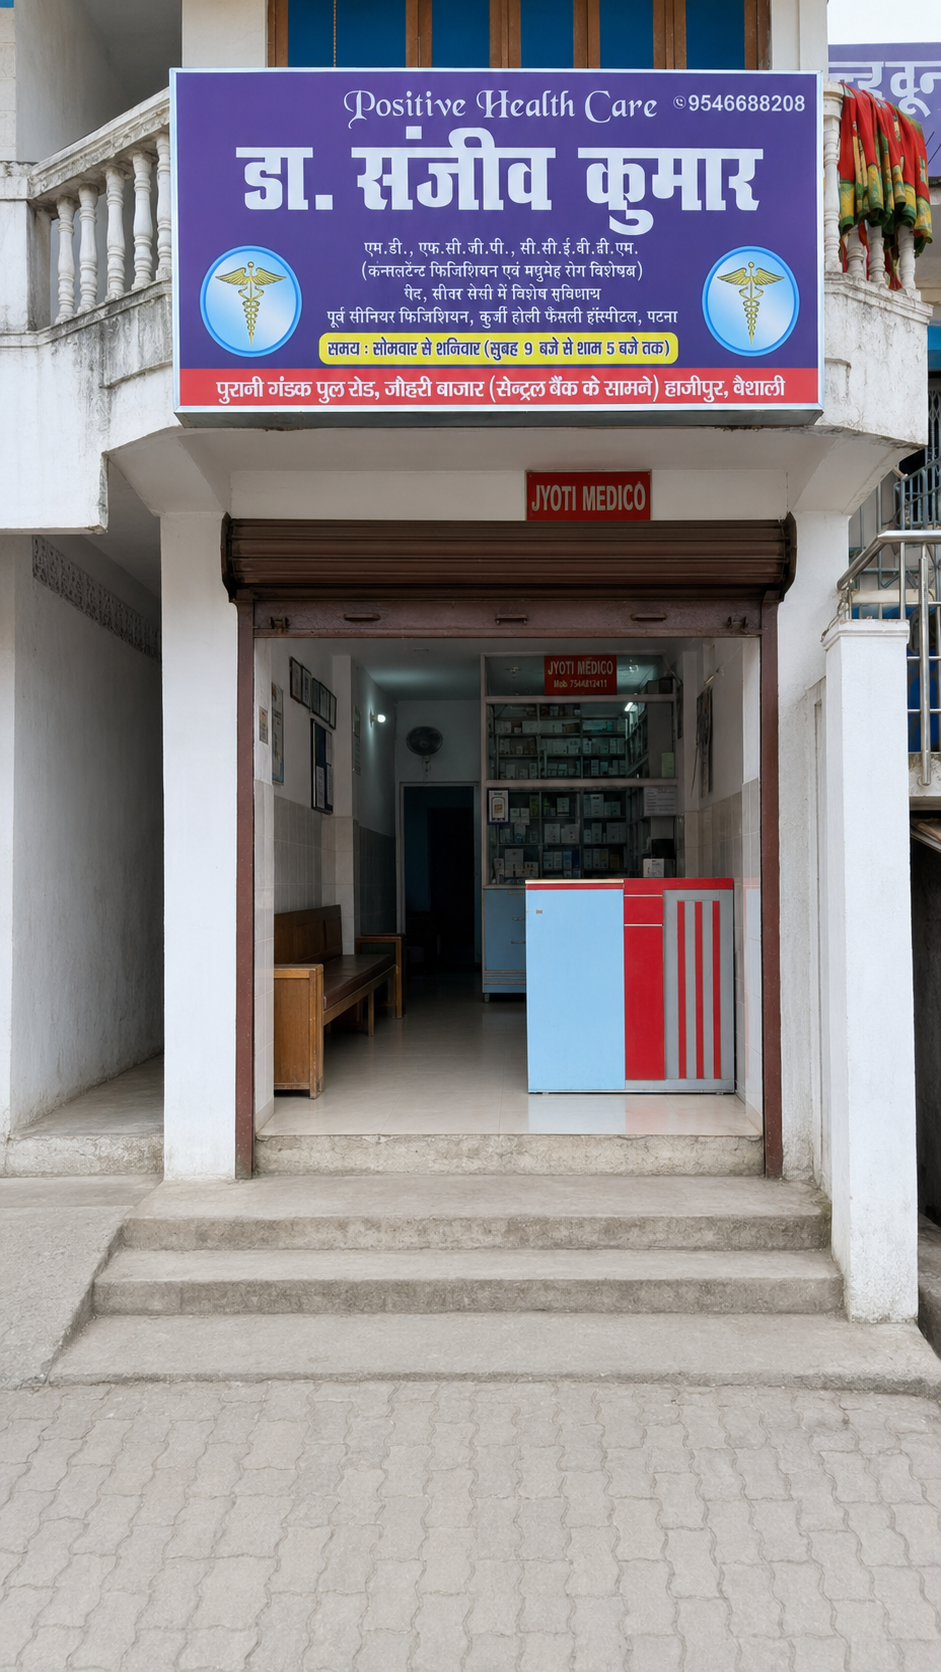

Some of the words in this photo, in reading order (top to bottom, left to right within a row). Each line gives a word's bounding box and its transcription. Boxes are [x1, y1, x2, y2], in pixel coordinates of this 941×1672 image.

[344, 90, 466, 129] Positive
[476, 90, 575, 118] Health
[584, 90, 657, 123] Care
[688, 95, 805, 111] 9546688208
[236, 147, 333, 210] डा.
[351, 126, 556, 210] संजीव
[578, 147, 764, 236] कुमार
[429, 261, 498, 280] फिजिशियन
[502, 261, 520, 279] एवं
[565, 260, 586, 278] रोग
[497, 283, 507, 300] में
[327, 306, 345, 328] पूर्व
[349, 306, 395, 323] सीनियर
[399, 306, 474, 326] फिजिशियन,
[511, 306, 541, 325] होली
[647, 310, 678, 323] पटना
[328, 342, 360, 356] समय
[373, 337, 418, 356] सोमवार
[421, 337, 432, 356] से
[437, 337, 481, 356] शनिवार
[524, 342, 533, 356] 9
[539, 337, 558, 356] बजे
[563, 337, 573, 356] से
[577, 341, 602, 356] शाम
[606, 342, 615, 355] 5
[619, 336, 638, 356] बजे
[642, 339, 670, 357] तक)
[216, 375, 264, 404] पुरानी
[267, 376, 312, 397] गंडक
[316, 381, 345, 403] पुल
[348, 376, 380, 400] रोड,
[384, 376, 432, 398] जौहरी
[436, 381, 485, 398] बाजार
[549, 375, 579, 397] बैंक
[582, 375, 600, 397] के
[604, 375, 659, 402] सामने)
[664, 375, 729, 403] हाजीपुर,
[531, 484, 577, 512] JYOTI
[582, 481, 646, 511] MEDICO
[548, 660, 575, 675] JYOTI
[577, 660, 614, 675] MEDICO
